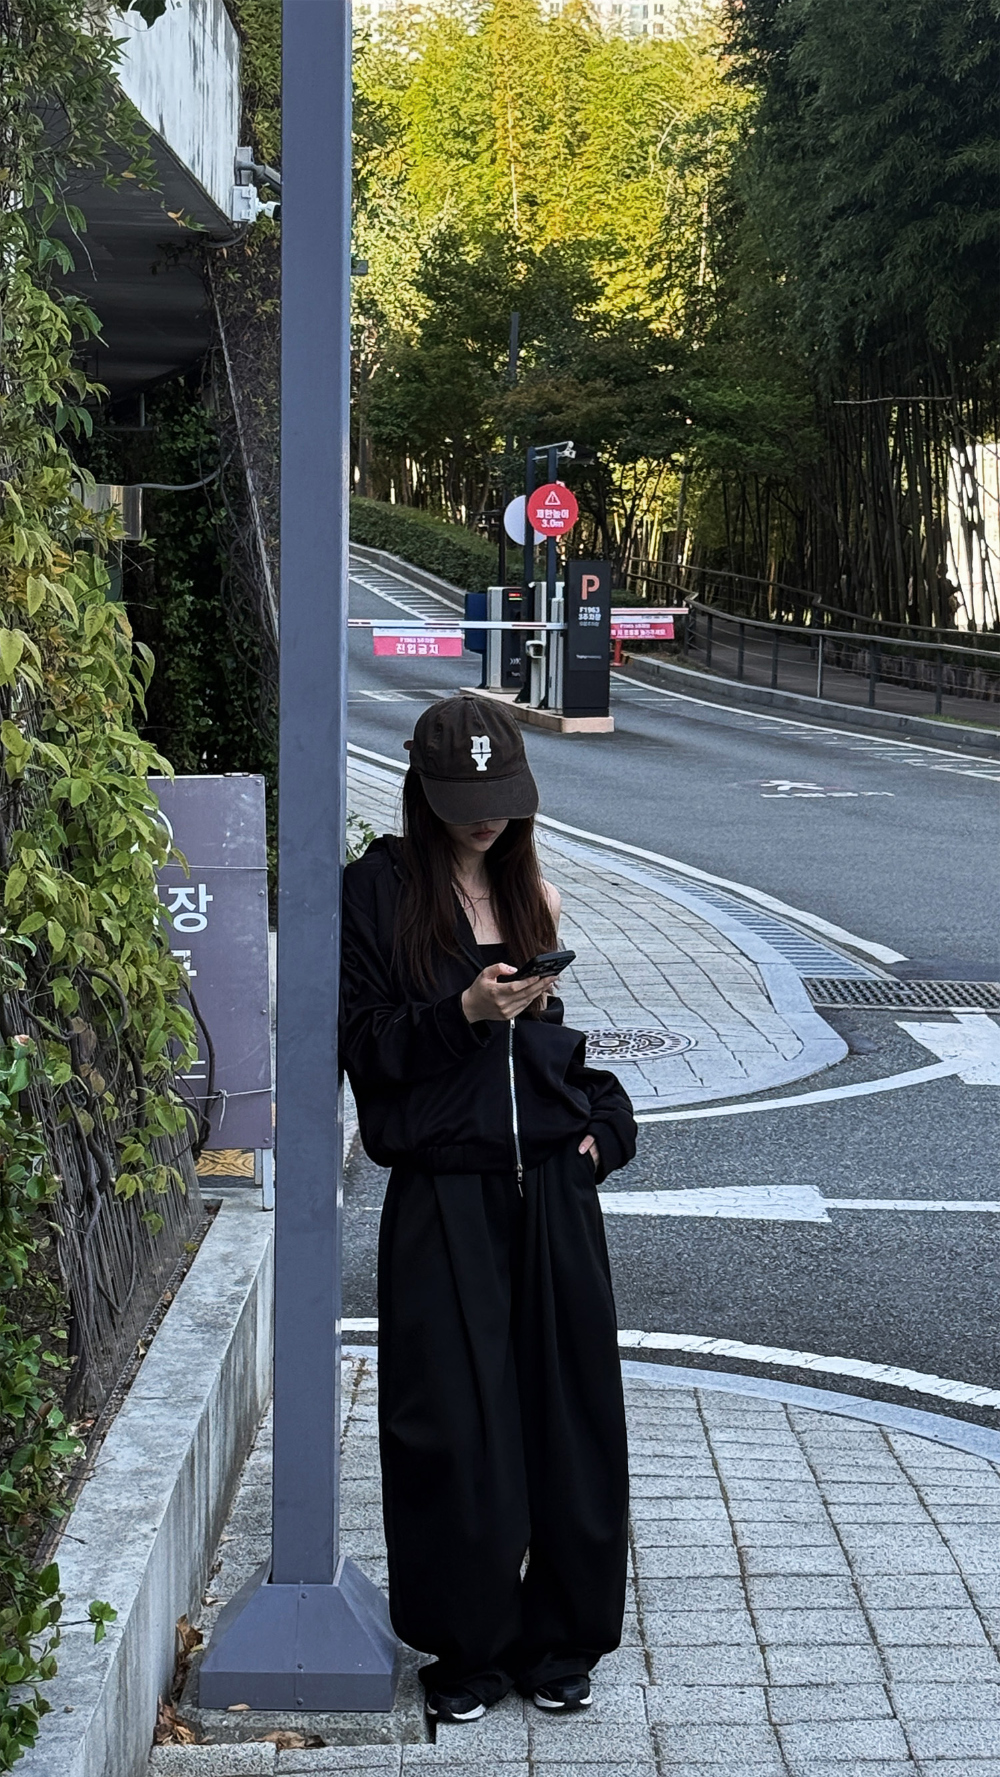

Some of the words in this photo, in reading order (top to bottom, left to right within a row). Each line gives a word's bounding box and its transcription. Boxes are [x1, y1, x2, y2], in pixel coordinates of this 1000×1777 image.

[536, 508, 569, 519] 제한높이
[541, 519, 564, 528] 3.0m
[580, 574, 600, 600] P
[578, 613, 602, 621] 3주차장
[396, 643, 439, 655] 진입금지
